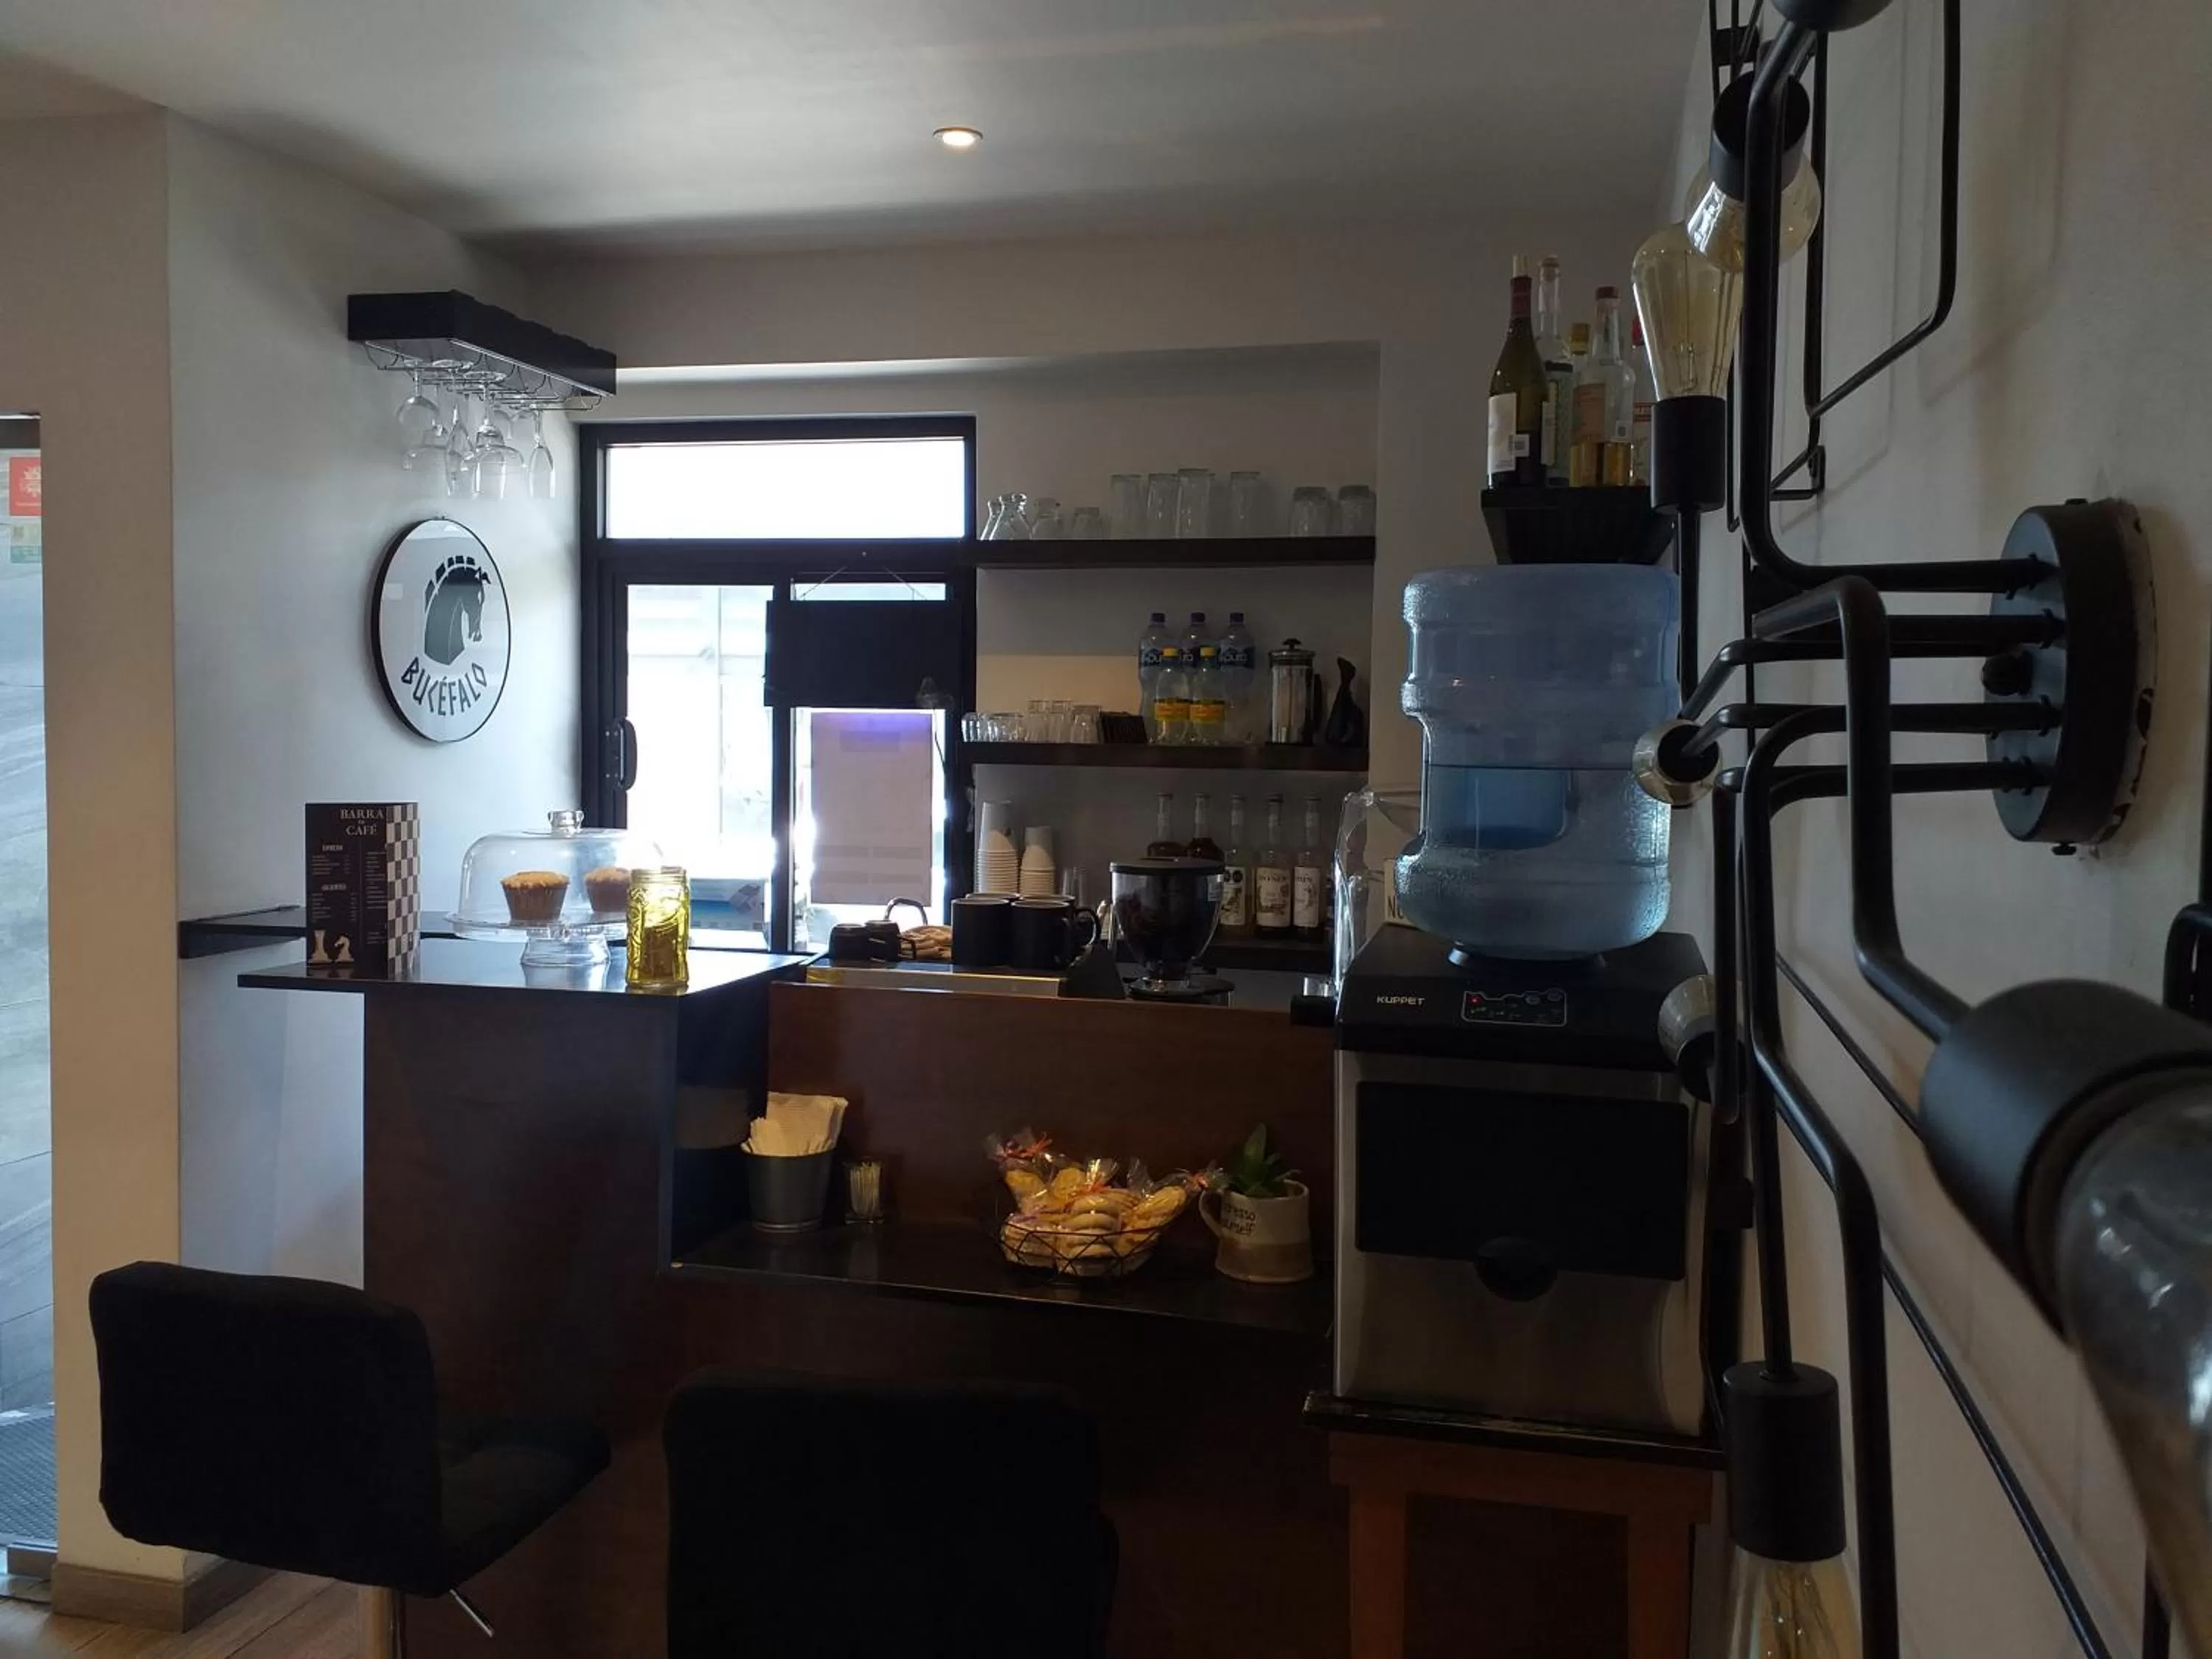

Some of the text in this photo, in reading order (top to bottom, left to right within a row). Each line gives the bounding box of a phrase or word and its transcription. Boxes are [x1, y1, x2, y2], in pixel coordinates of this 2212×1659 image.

[401, 656, 487, 715] BUCÉFALO
[340, 808, 384, 819] BARRA
[345, 824, 377, 835] CAFÉ
[1377, 995, 1425, 1006] KUPPET
